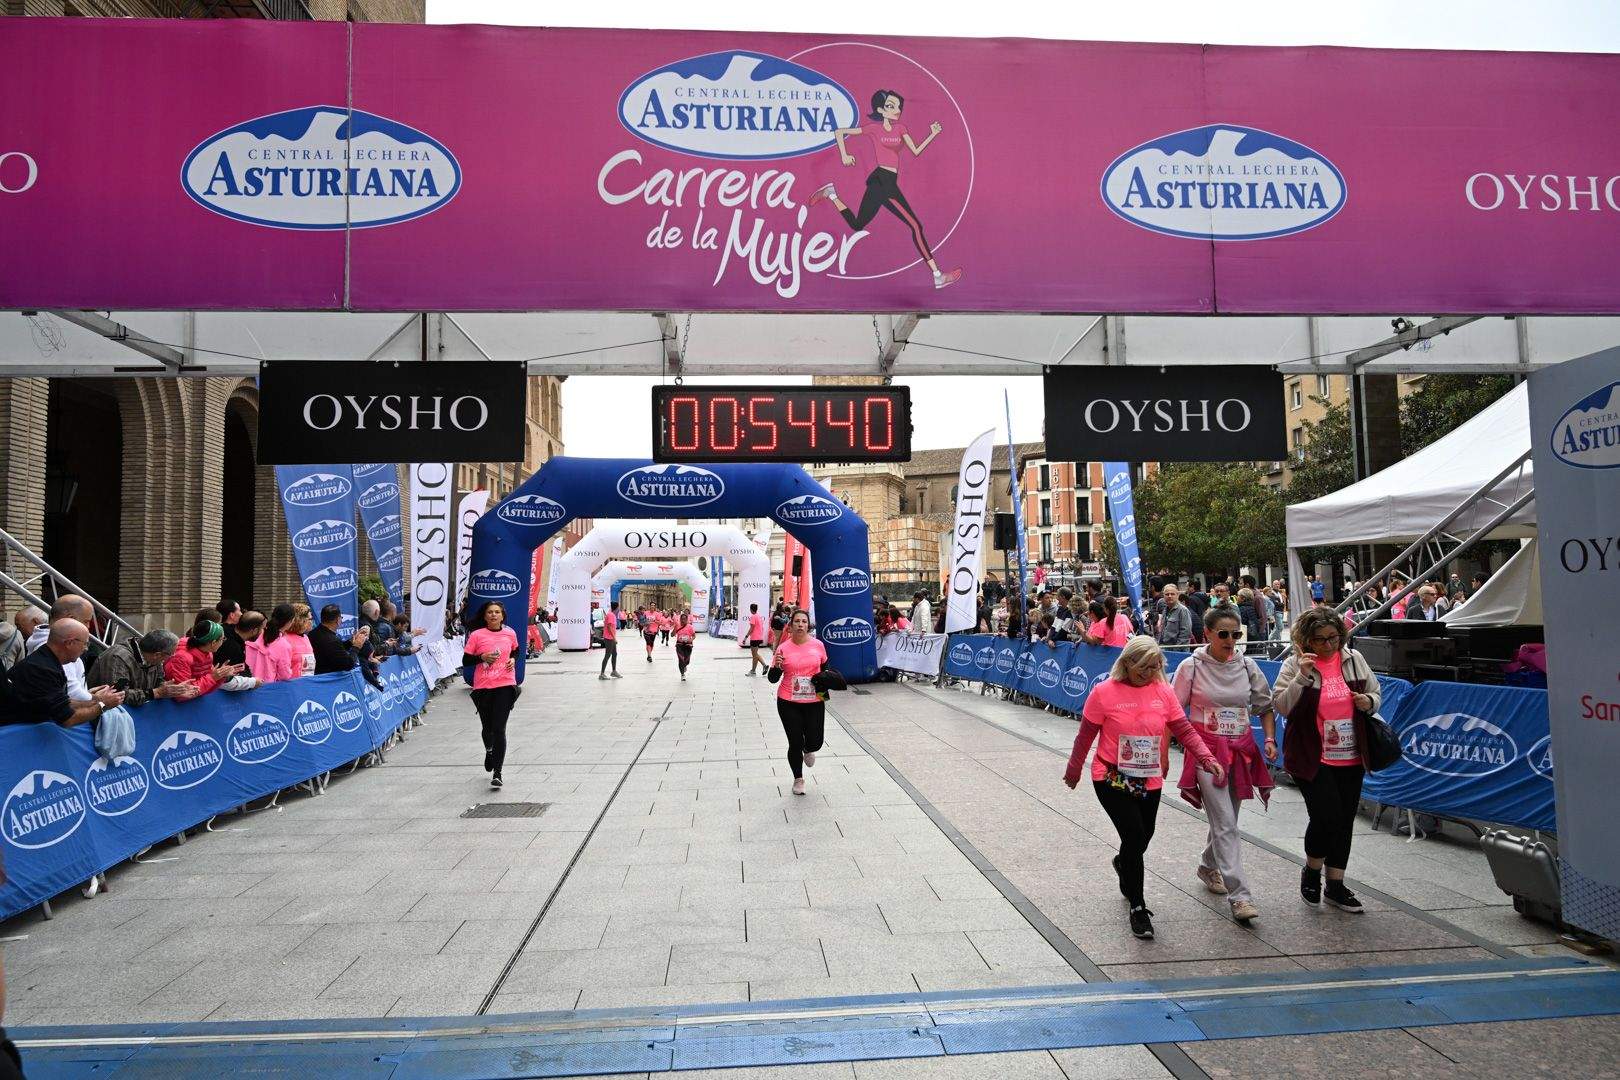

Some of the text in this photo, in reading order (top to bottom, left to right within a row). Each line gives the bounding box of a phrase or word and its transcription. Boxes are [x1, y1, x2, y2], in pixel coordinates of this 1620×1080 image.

[675, 87, 832, 100] CENTRAL LECHERA
[637, 88, 838, 133] ASTURIANA
[248, 149, 431, 162] CENTRAL LECHERA
[1159, 164, 1319, 176] CENTRAL LECHERA
[203, 151, 440, 198] ASTURIANA
[597, 149, 797, 209] Carrera
[1121, 166, 1328, 210] ASTURIANA
[646, 206, 870, 298] de la Mujer
[303, 394, 488, 431] OYSHO
[1084, 399, 1251, 433] OYSHO
[1561, 424, 1620, 454] ASTU
[625, 478, 716, 496] ASTURIANA
[500, 506, 560, 518] ASTURIANA
[781, 508, 838, 518] ASTURIANA
[416, 463, 447, 606] OYSHO
[624, 532, 707, 548] OYSHO
[954, 460, 986, 596] OYSHO
[1560, 538, 1620, 573] OY
[471, 580, 517, 592] ASTURIANA
[824, 579, 868, 590] ASTURIANA
[826, 628, 870, 640] ASTURIANA
[896, 636, 934, 655] OYSHO
[298, 718, 330, 738] ASTURIANA
[234, 731, 286, 756] ASTURIANA
[1405, 732, 1506, 765] ASTURIANA
[158, 750, 220, 782] ASTURIANA
[20, 786, 75, 812] CENTRAL LECHERA
[90, 774, 146, 806] ASTURIANA
[10, 796, 84, 839] ASTURIANA
